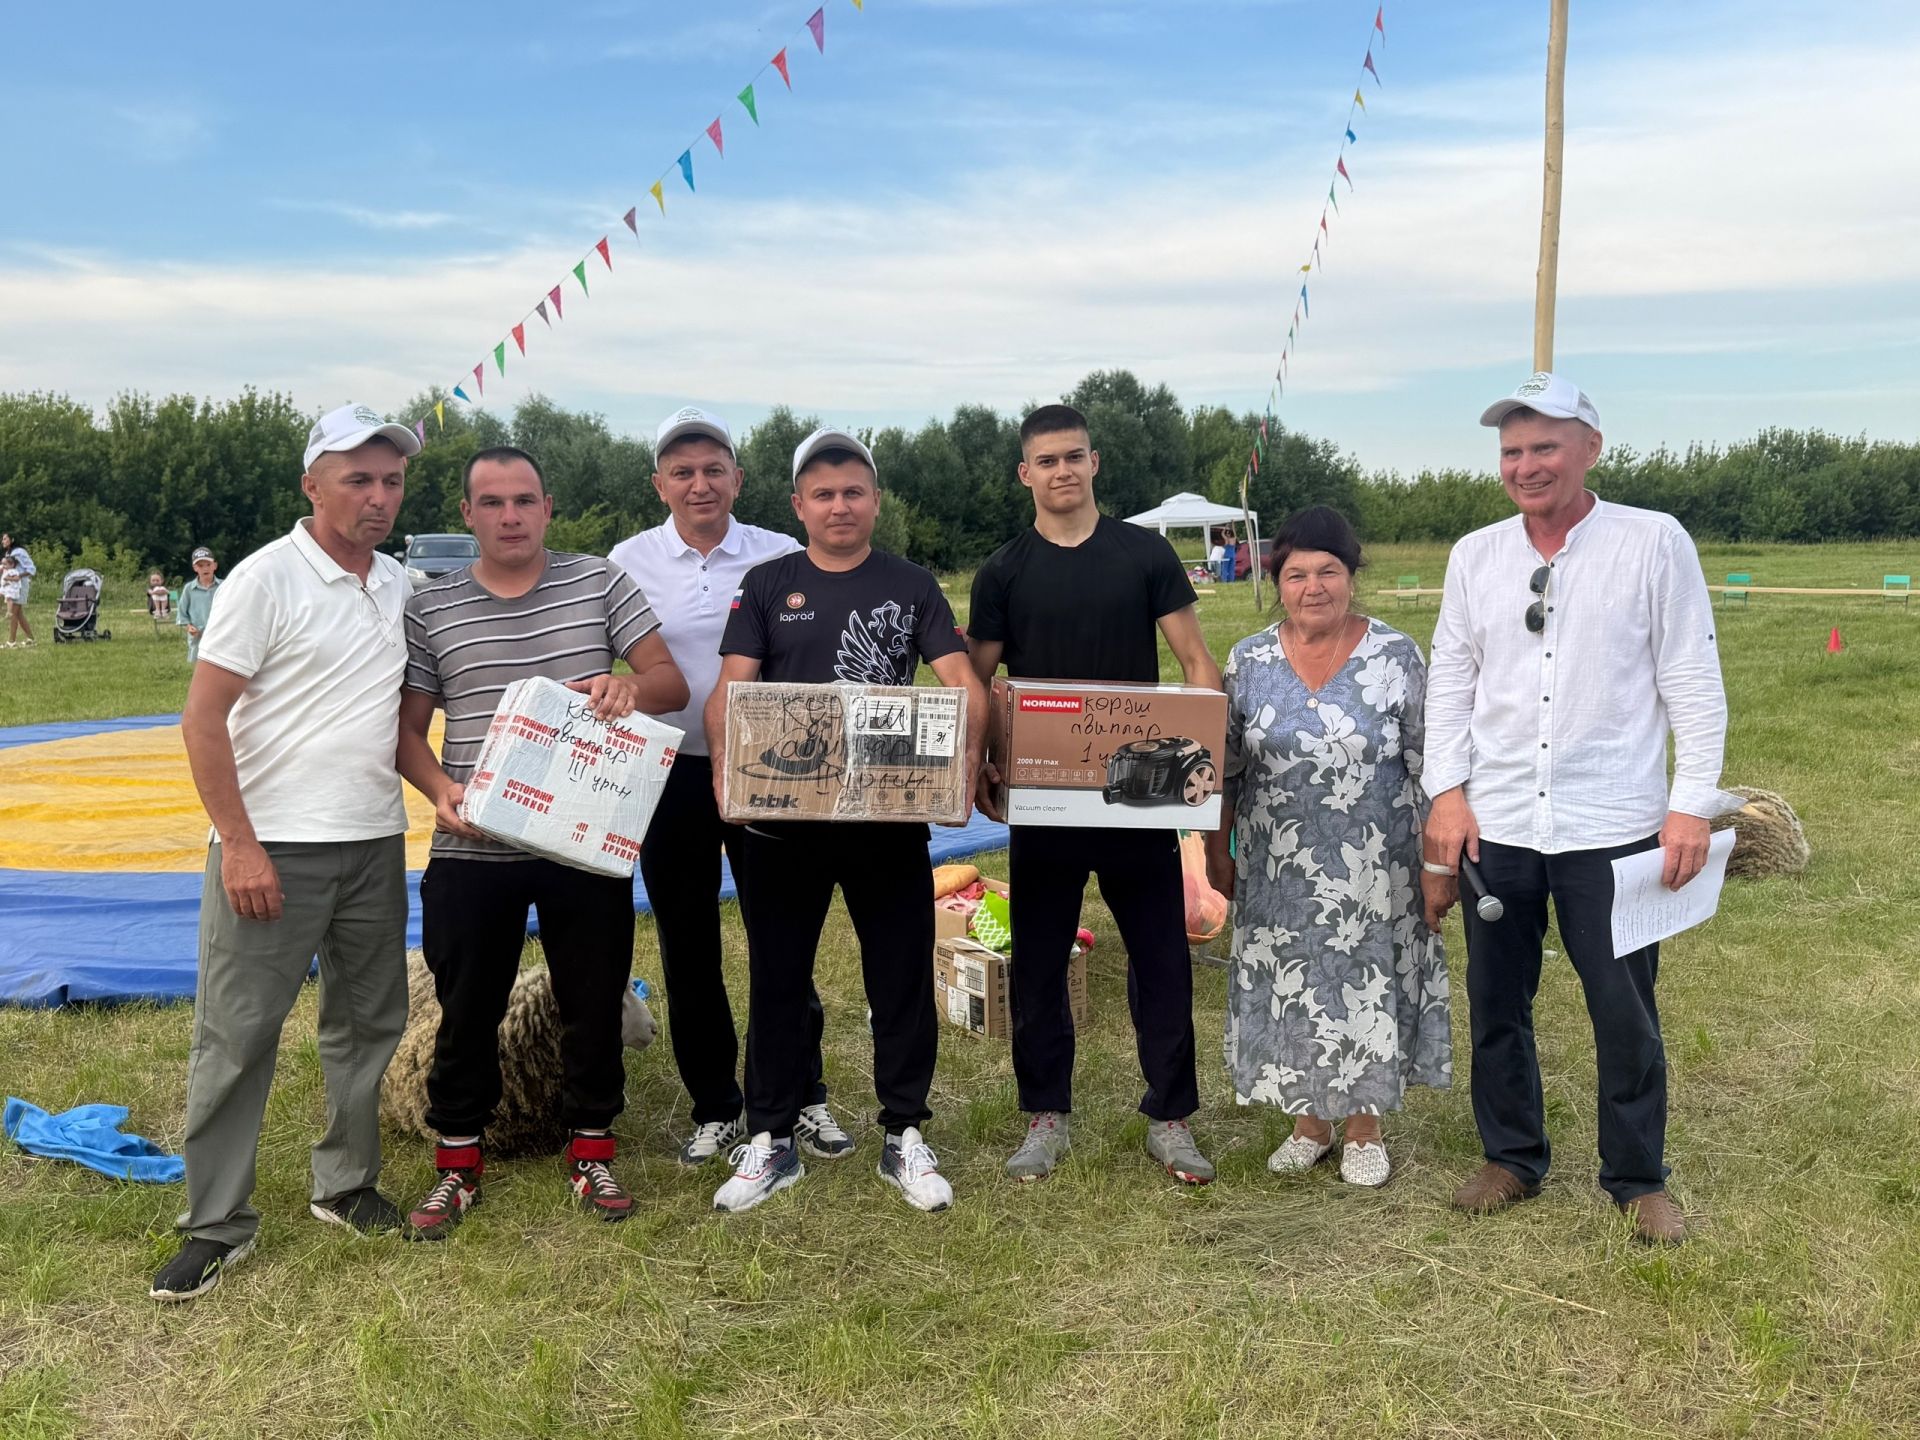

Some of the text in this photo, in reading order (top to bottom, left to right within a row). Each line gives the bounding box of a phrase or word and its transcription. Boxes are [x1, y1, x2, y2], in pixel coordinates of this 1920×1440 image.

[780, 611, 815, 622] laprad
[1022, 699, 1079, 709] NORMANN
[1016, 757, 1034, 766] 2000
[1034, 758, 1043, 766] W
[1042, 804, 1067, 812] cleaner
